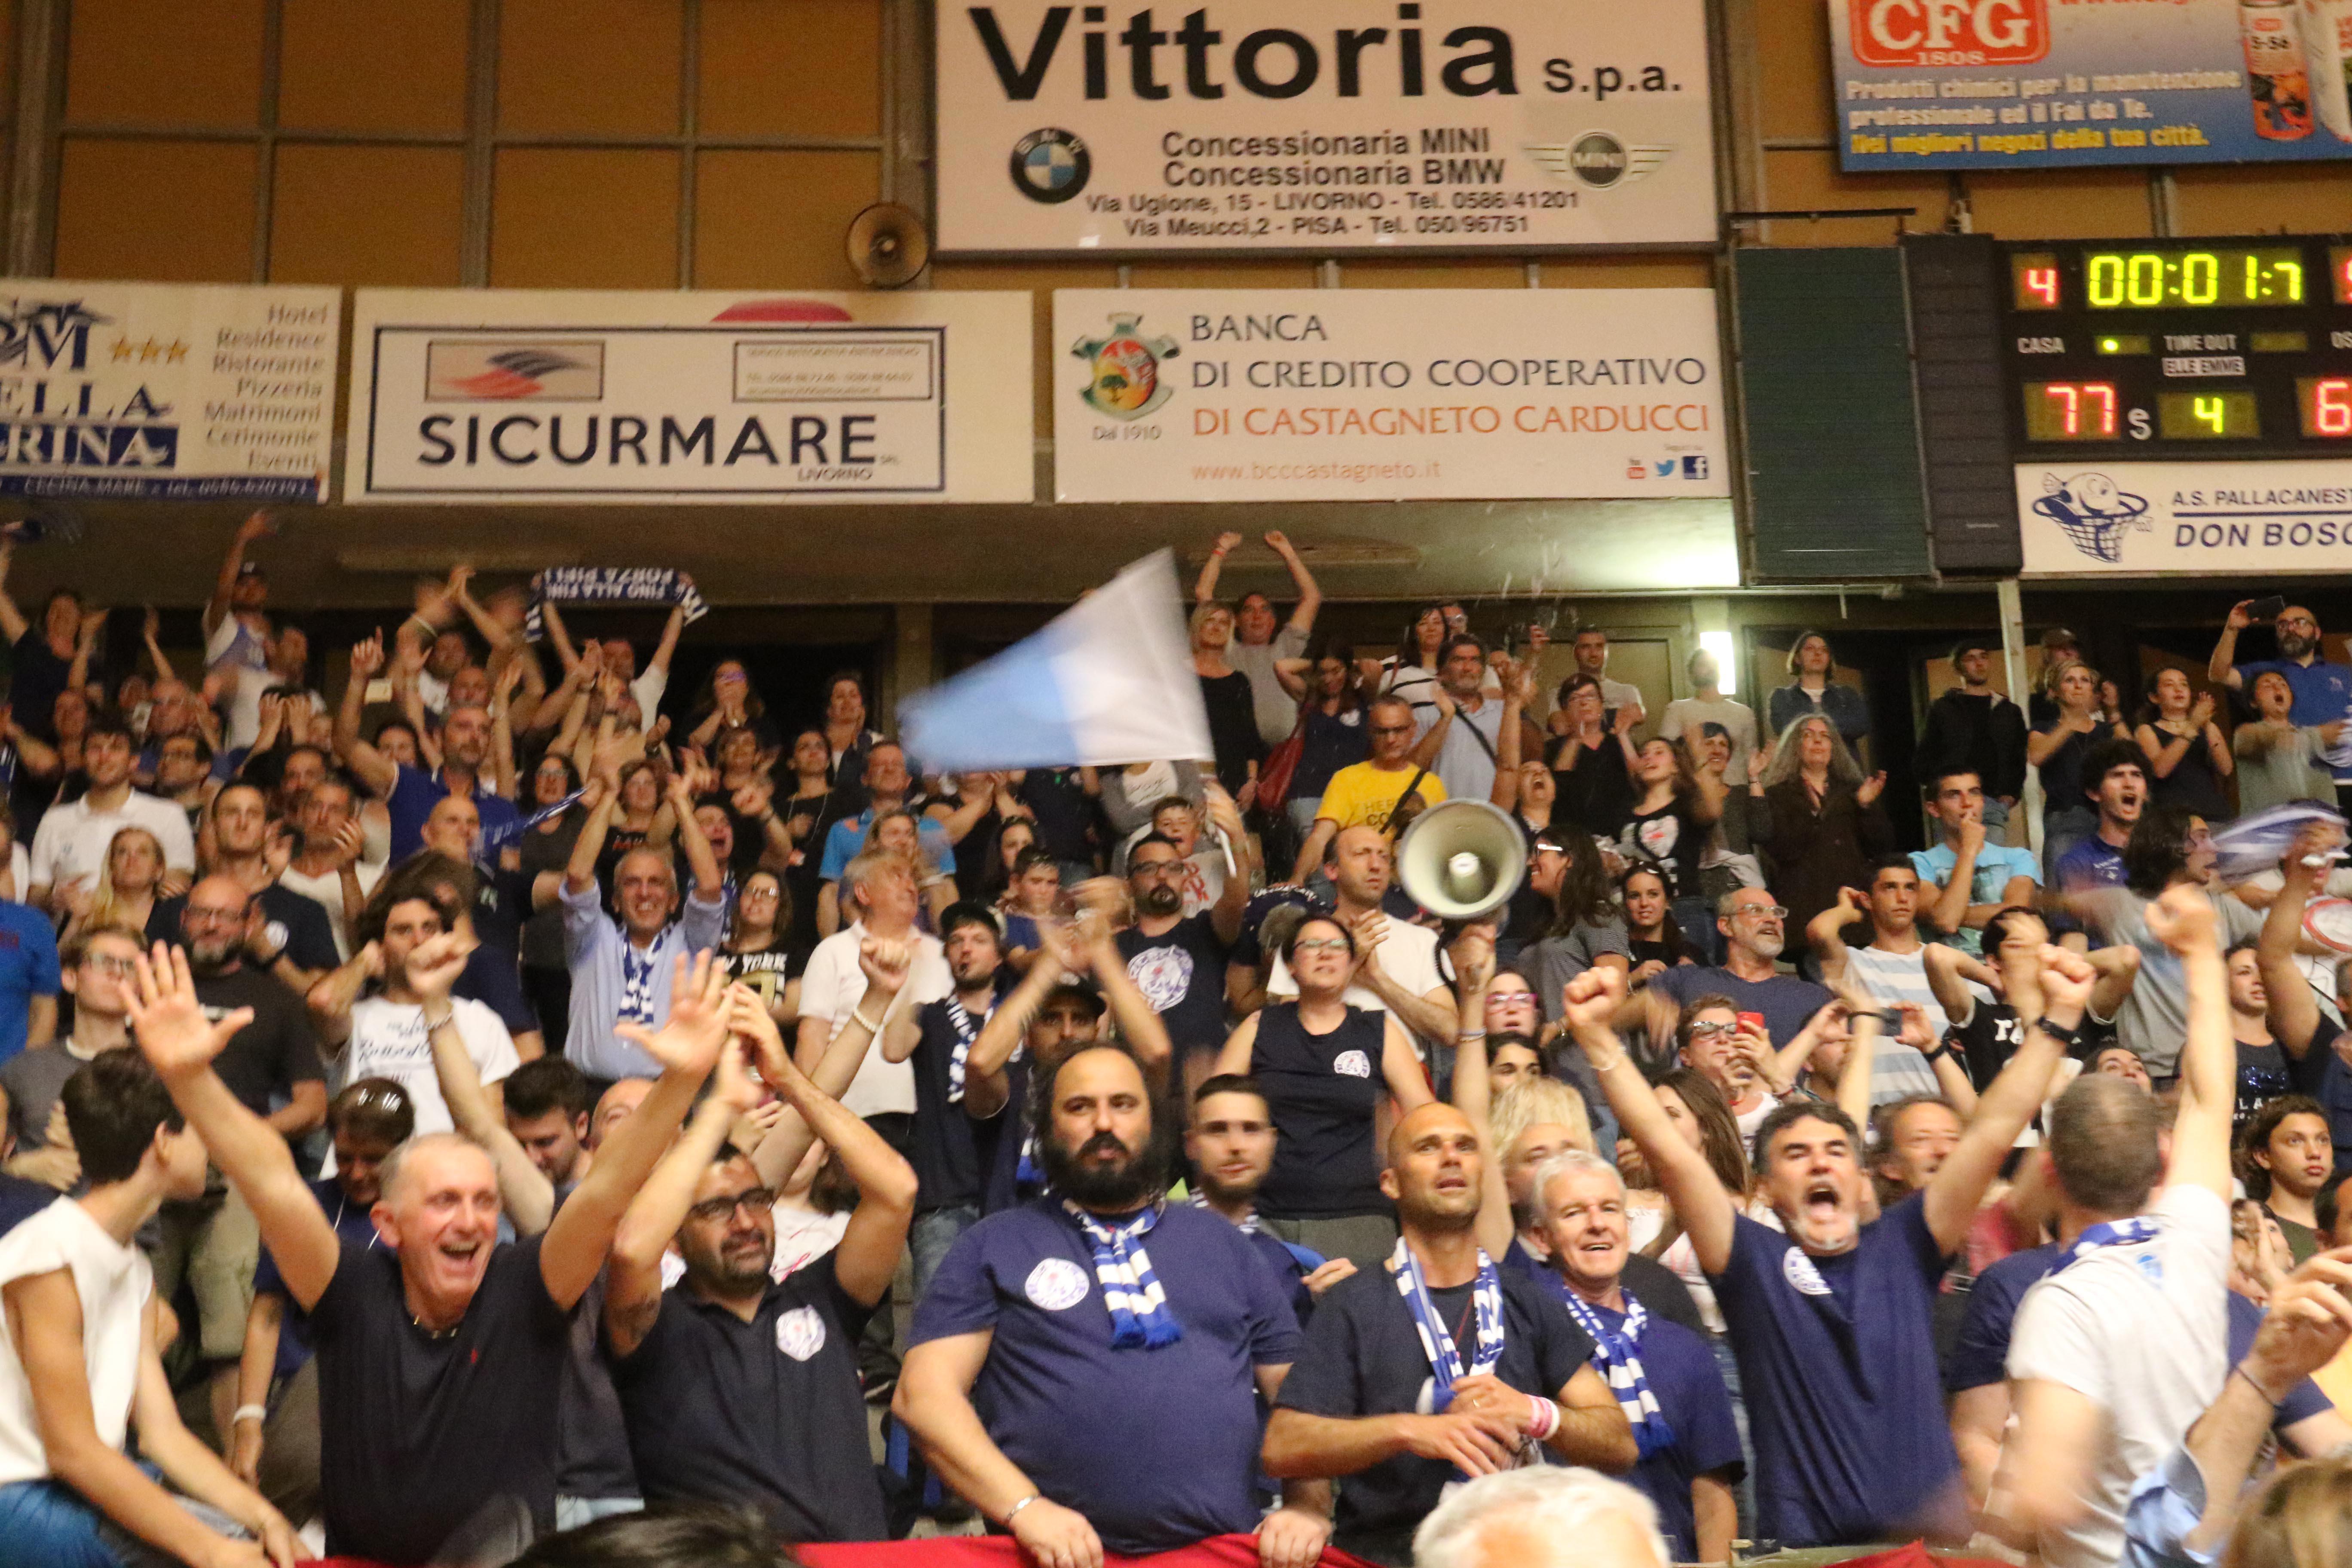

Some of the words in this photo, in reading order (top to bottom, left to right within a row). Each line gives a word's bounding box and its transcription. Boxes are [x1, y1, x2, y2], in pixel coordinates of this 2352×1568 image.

[1868, 0, 2031, 49] CFG
[967, 3, 1519, 101] Vittoria
[1544, 57, 1681, 100] s.p.a.
[1846, 77, 1936, 99] Prodotti
[1940, 77, 2017, 98] chimici
[2021, 78, 2062, 99] per
[2065, 73, 2088, 93] la
[2092, 69, 2242, 92] manutenzione
[1849, 106, 1997, 129] professionale
[1999, 104, 2027, 123] ed
[2030, 102, 2049, 122] il
[2050, 100, 2085, 122] Fai
[2089, 100, 2117, 119] da
[1162, 129, 1409, 157] Concessionaria
[1421, 128, 1490, 154] MINI
[1851, 133, 1887, 154] Nei
[1891, 133, 1974, 156] migliori
[1978, 131, 2048, 155] negozi
[2051, 128, 2105, 149] della
[2110, 128, 2147, 147] tua
[1164, 159, 1411, 187] Concessionaria
[1423, 158, 1506, 184] BMW
[1086, 193, 1121, 212] Via
[1226, 193, 1252, 211] 15
[1274, 192, 1384, 211] LIVORNO
[1123, 217, 1159, 236] Via
[1291, 216, 1348, 235] PISA
[2027, 268, 2057, 305] 4
[268, 303, 328, 323] Hotel
[217, 328, 326, 349] Residence
[1191, 314, 1328, 341] BANCA
[2018, 337, 2066, 353] CASA
[2163, 334, 2203, 351] TIME
[2204, 334, 2237, 350] OUT
[213, 354, 325, 373] Ristorante
[1192, 361, 1229, 388] DI
[1247, 361, 1411, 388] CREDITO
[1428, 358, 1706, 386] COOPERATIVO
[236, 377, 322, 398] Pizzeria
[205, 401, 321, 422] Matrimoni
[2046, 381, 2116, 434] 77
[2194, 397, 2224, 433] 4
[1194, 408, 1230, 436] DI
[1243, 405, 1501, 436] CASTAGNETO
[1514, 404, 1709, 433] CARDUCCI
[417, 414, 877, 467] SICURMARE
[1124, 424, 1161, 441] 1910
[248, 449, 317, 470] Eventi
[1192, 460, 1441, 482] www.bcccastagneto.it
[797, 467, 874, 482] LIVORNO
[2173, 490, 2207, 506] A.S.
[2175, 523, 2250, 547] DON
